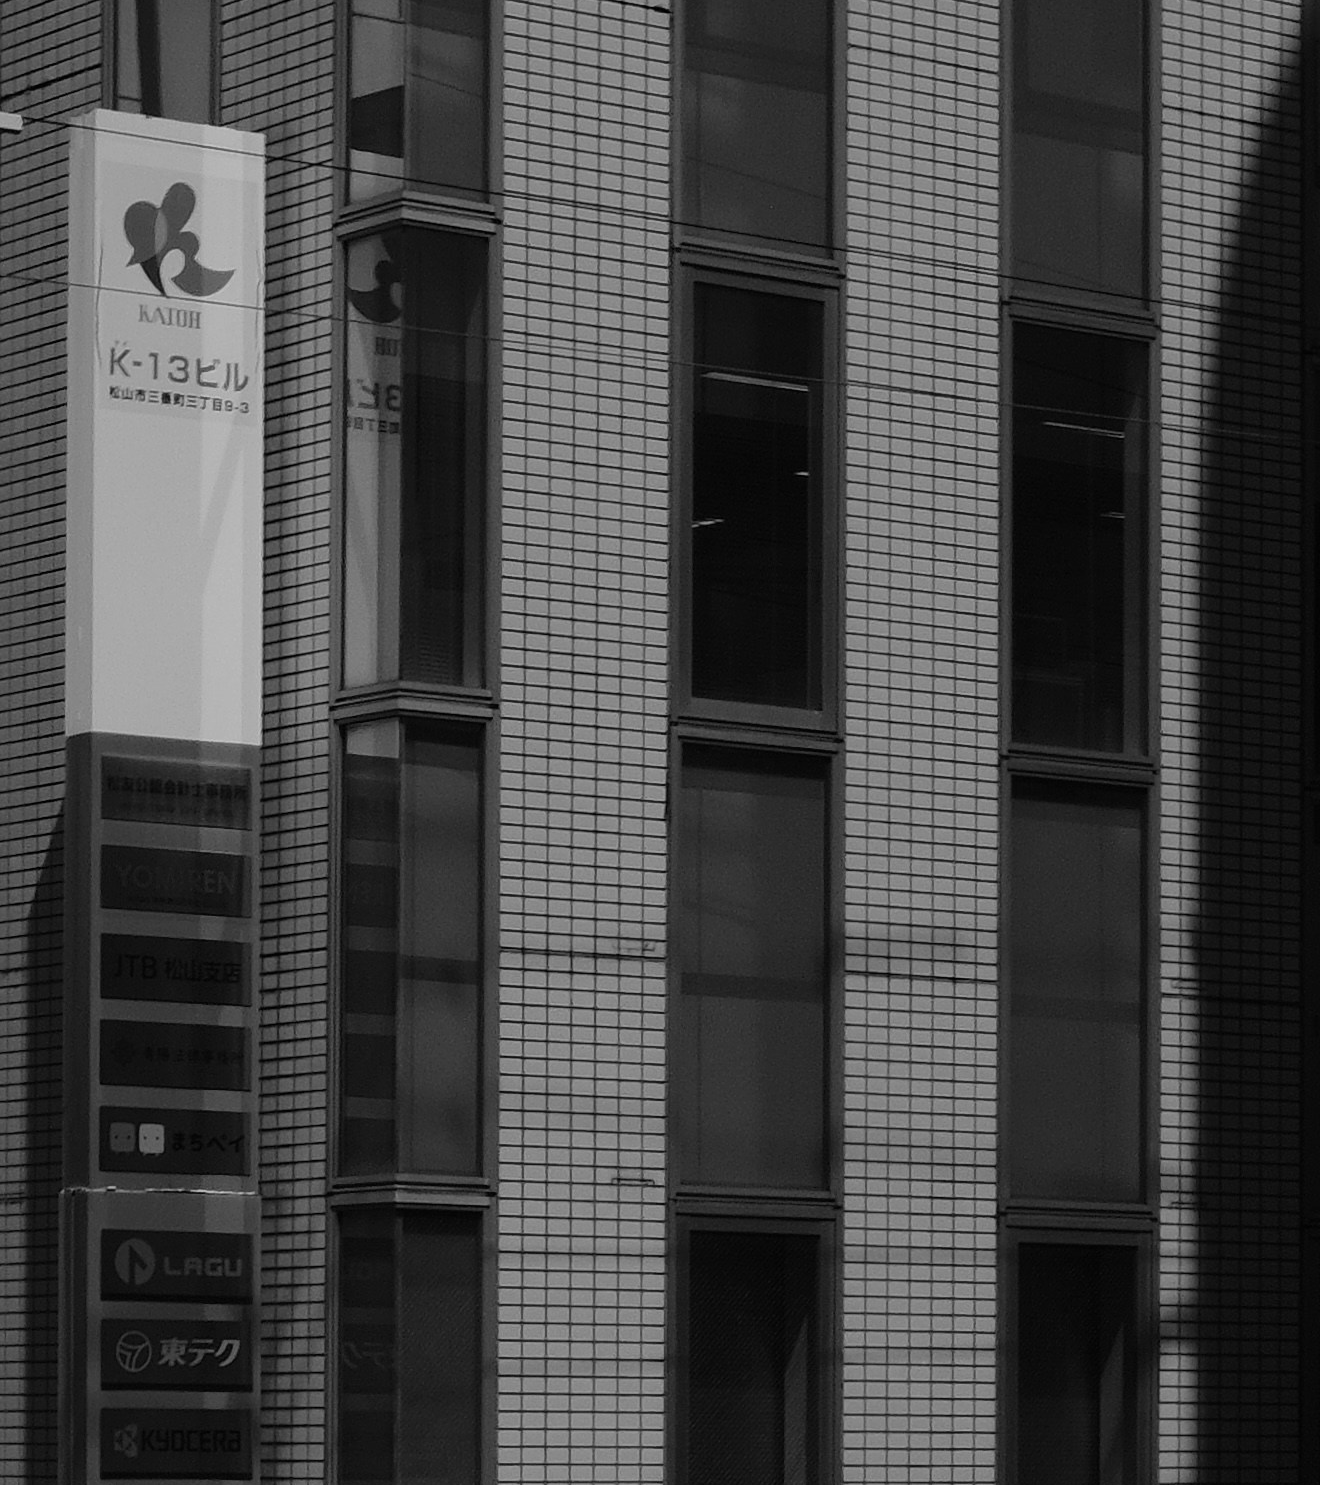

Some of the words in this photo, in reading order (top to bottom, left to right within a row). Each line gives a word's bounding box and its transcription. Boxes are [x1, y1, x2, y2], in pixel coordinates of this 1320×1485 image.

[109, 345, 249, 392] K-13ビル
[113, 954, 157, 980] JTB
[164, 957, 242, 983] 松山支店
[163, 1256, 243, 1278] LAGU
[157, 1336, 241, 1367] 東テク
[141, 1429, 242, 1453] KYOCERA
